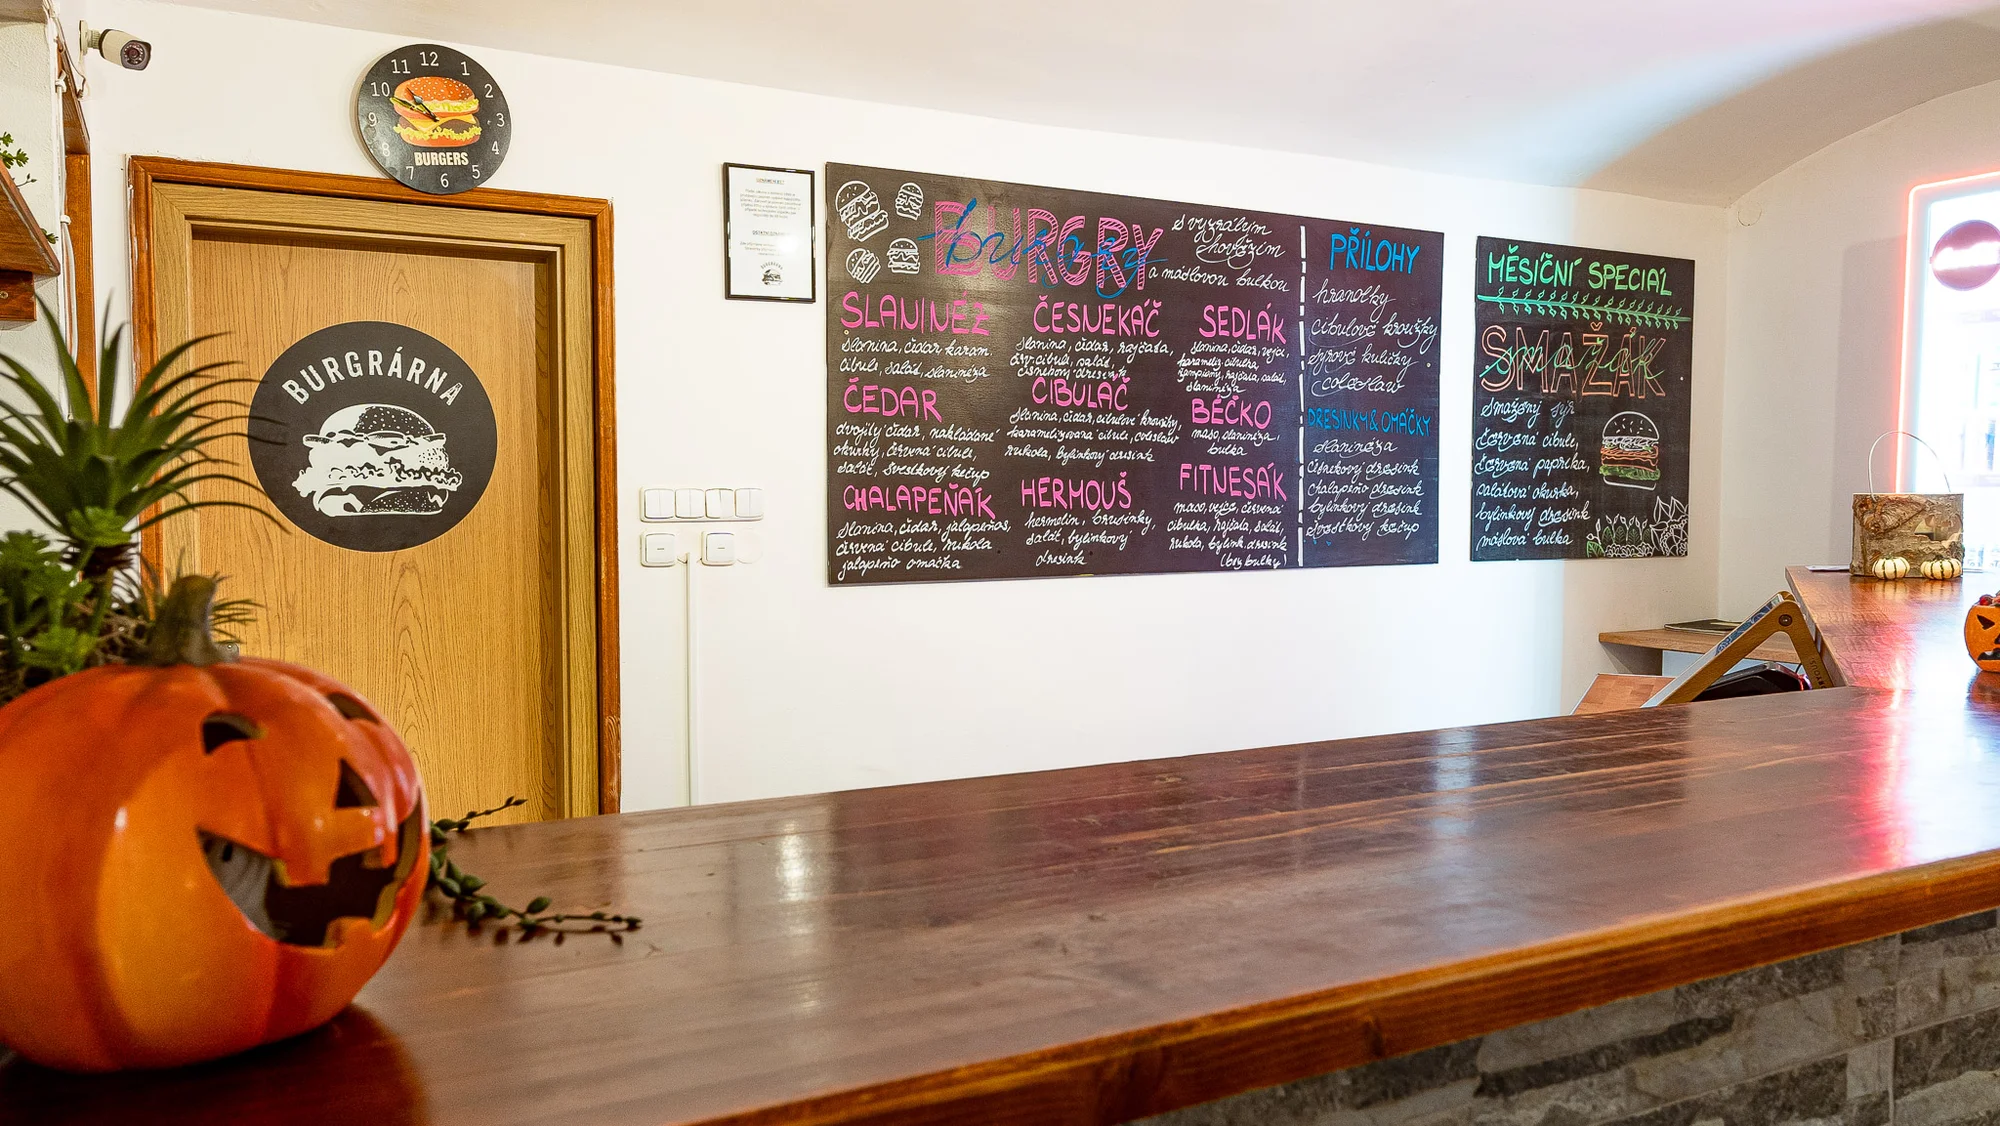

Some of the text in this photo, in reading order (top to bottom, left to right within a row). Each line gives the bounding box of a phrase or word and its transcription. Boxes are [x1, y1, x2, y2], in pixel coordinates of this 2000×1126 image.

[391, 59, 411, 74] 11
[419, 51, 439, 66] 12
[460, 61, 470, 76] 1
[370, 82, 390, 97] 10
[484, 83, 494, 98] 2
[368, 112, 377, 127] 9
[496, 112, 505, 127] 3
[382, 142, 391, 157] 8
[414, 152, 469, 166] BURGERS
[491, 141, 500, 155] 4
[405, 165, 414, 180] 7
[440, 173, 449, 188] 6
[471, 164, 481, 179] 5
[934, 201, 1164, 291] BURGRY
[1329, 227, 1420, 274] PŘÍLOHY
[1148, 265, 1290, 292] a máslovou bulkou
[1487, 244, 1673, 296] MĚSÍČNÍ SPECIÁL
[1312, 278, 1396, 322] hranolky
[1033, 294, 1162, 338] ČESNEKÁČ
[1199, 302, 1287, 345] SEDLÁK
[1382, 312, 1438, 355] kroužky
[944, 339, 993, 357] karam.
[1480, 321, 1667, 399] SMAŽÁK
[281, 346, 463, 406] BURGRÁRNA
[843, 377, 942, 422] ČEDAR
[1031, 373, 1131, 411] CIBULÁČ
[1191, 394, 1272, 429] BÉČKO
[1307, 407, 1431, 436] DRESINKY & OMÁČKY
[1207, 442, 1248, 456] bulka
[1021, 471, 1132, 511] HERMOUŠ
[1180, 462, 1287, 501] FITNESÁK
[1533, 528, 1573, 546] bulka
